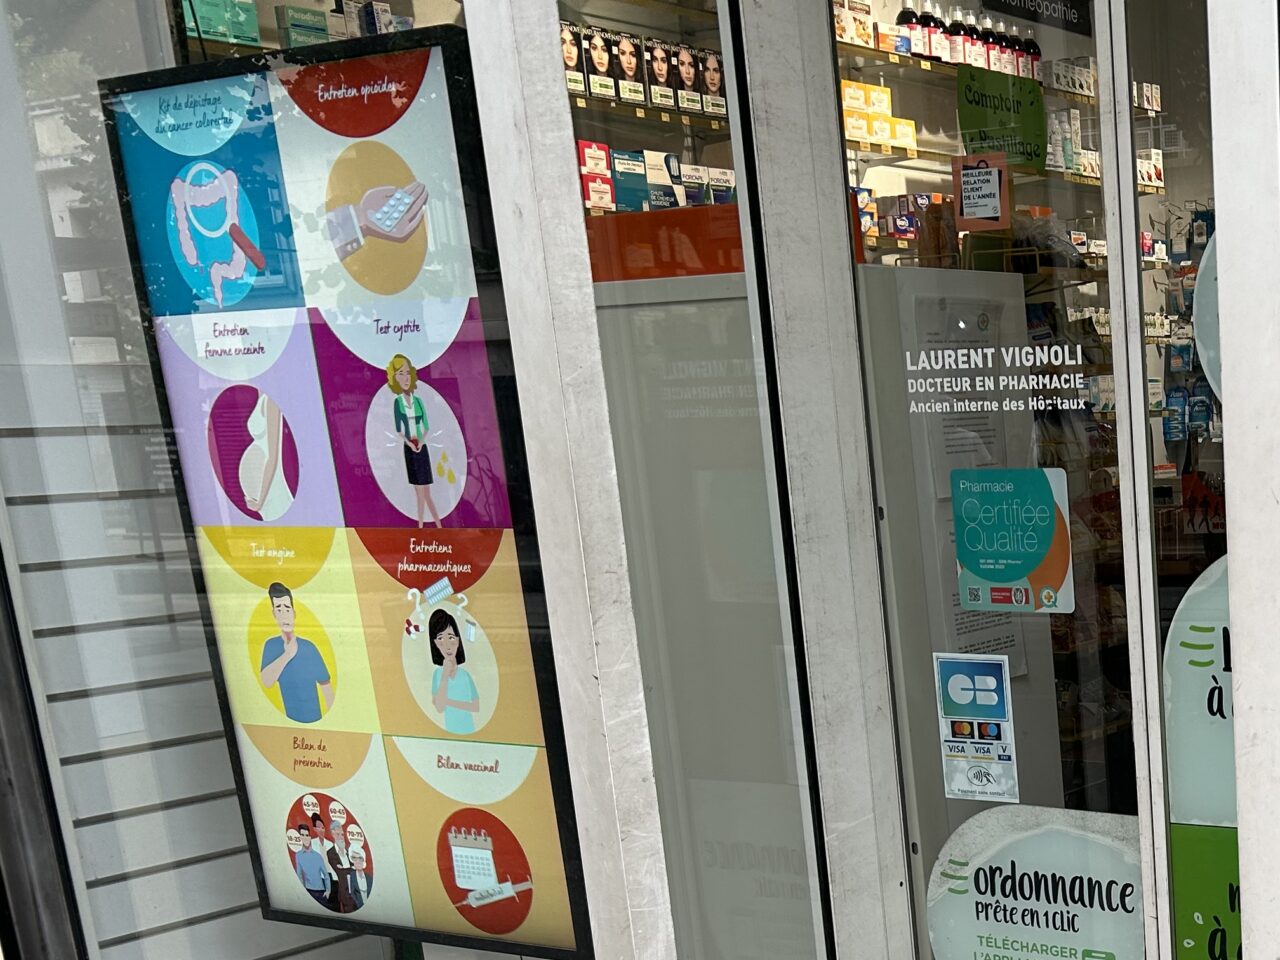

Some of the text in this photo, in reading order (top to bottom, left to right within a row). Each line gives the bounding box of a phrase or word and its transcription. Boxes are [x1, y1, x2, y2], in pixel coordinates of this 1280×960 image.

[315, 84, 359, 102] Entretien
[965, 84, 1022, 114] Comptoir
[158, 96, 170, 115] Kit
[963, 186, 983, 194] CLIENT
[213, 322, 250, 343] Entretien
[373, 318, 421, 341] Test cystite
[204, 342, 266, 360] femme enceinte
[906, 344, 1083, 370] LAURENT VIGNOLI
[908, 373, 1085, 393] DOCTEUR EN PHARMACIE
[909, 400, 950, 413] Ancien
[953, 398, 999, 412] interne
[1003, 397, 1025, 411] des
[960, 480, 1014, 492] Pharmacie
[962, 498, 1050, 526] Certifiée
[410, 538, 452, 554] Entretiens
[964, 524, 1038, 552] Qualité
[397, 557, 472, 577] pharmaceutiques
[1207, 675, 1227, 719] à
[293, 736, 327, 752] Bilan de
[948, 745, 966, 754] VISA
[974, 746, 991, 755] VISA
[293, 754, 333, 771] prévention
[437, 754, 500, 774] Bilan vaccinal
[974, 860, 1135, 913] ordonnance
[975, 899, 1018, 925] prête
[1021, 908, 1041, 928] en
[1043, 910, 1050, 928] 1
[977, 933, 1078, 959] TÉLÉCHARGER
